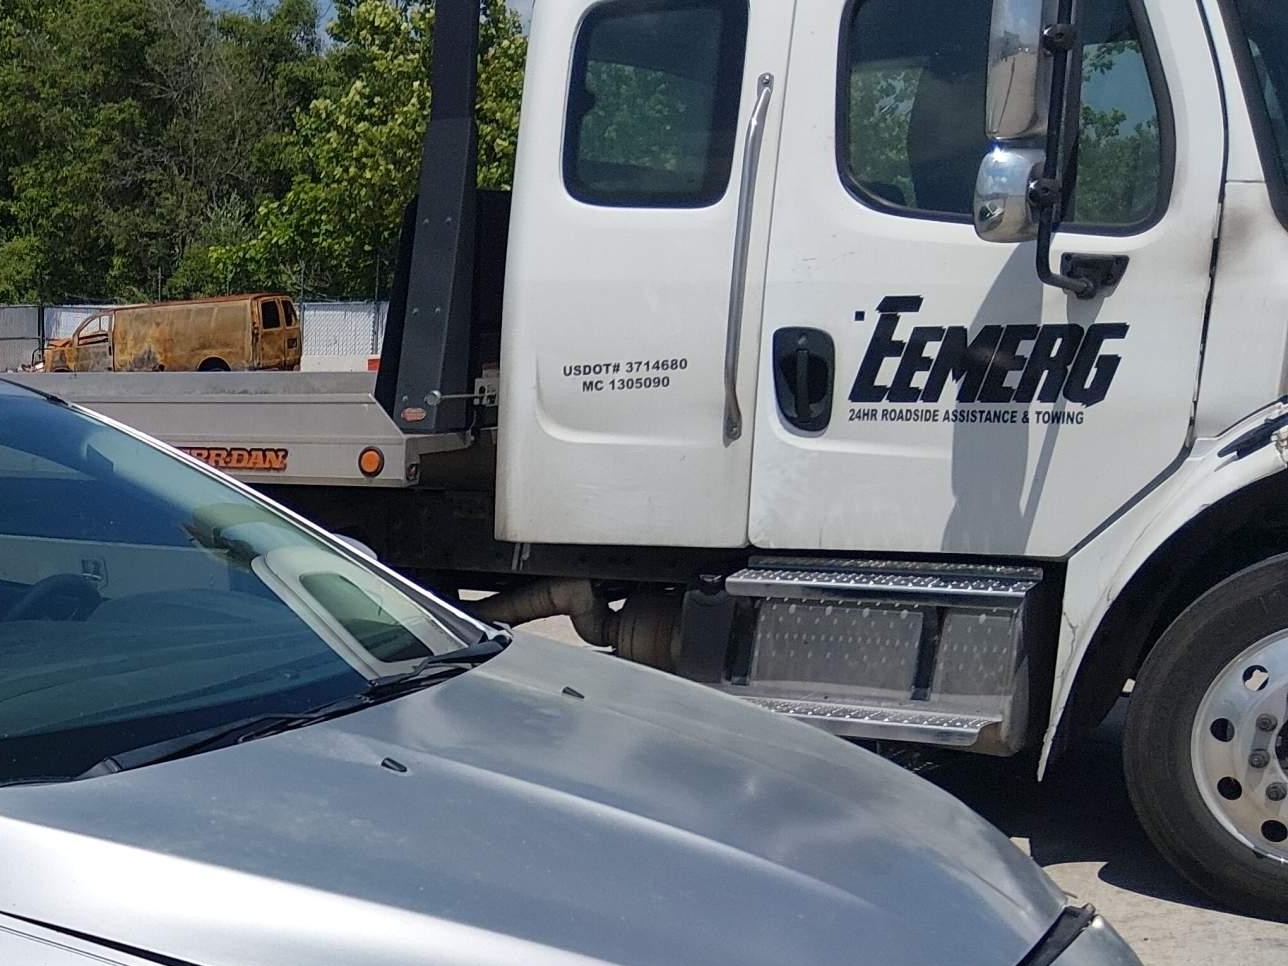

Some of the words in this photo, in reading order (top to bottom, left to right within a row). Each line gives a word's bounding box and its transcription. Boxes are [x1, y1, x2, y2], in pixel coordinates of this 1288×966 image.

[848, 295, 1130, 407] EEMERG
[562, 362, 621, 377] USDOT#
[625, 357, 688, 373] 3714680
[581, 380, 604, 393] MC
[608, 375, 670, 391] 1305090
[848, 408, 878, 422] 24HR
[880, 408, 939, 423] ROADSIDE
[942, 409, 1018, 424] ASSISTANCE
[1020, 410, 1030, 424] &
[1034, 410, 1085, 425] TOWING
[177, 447, 288, 471] RR-DAN
